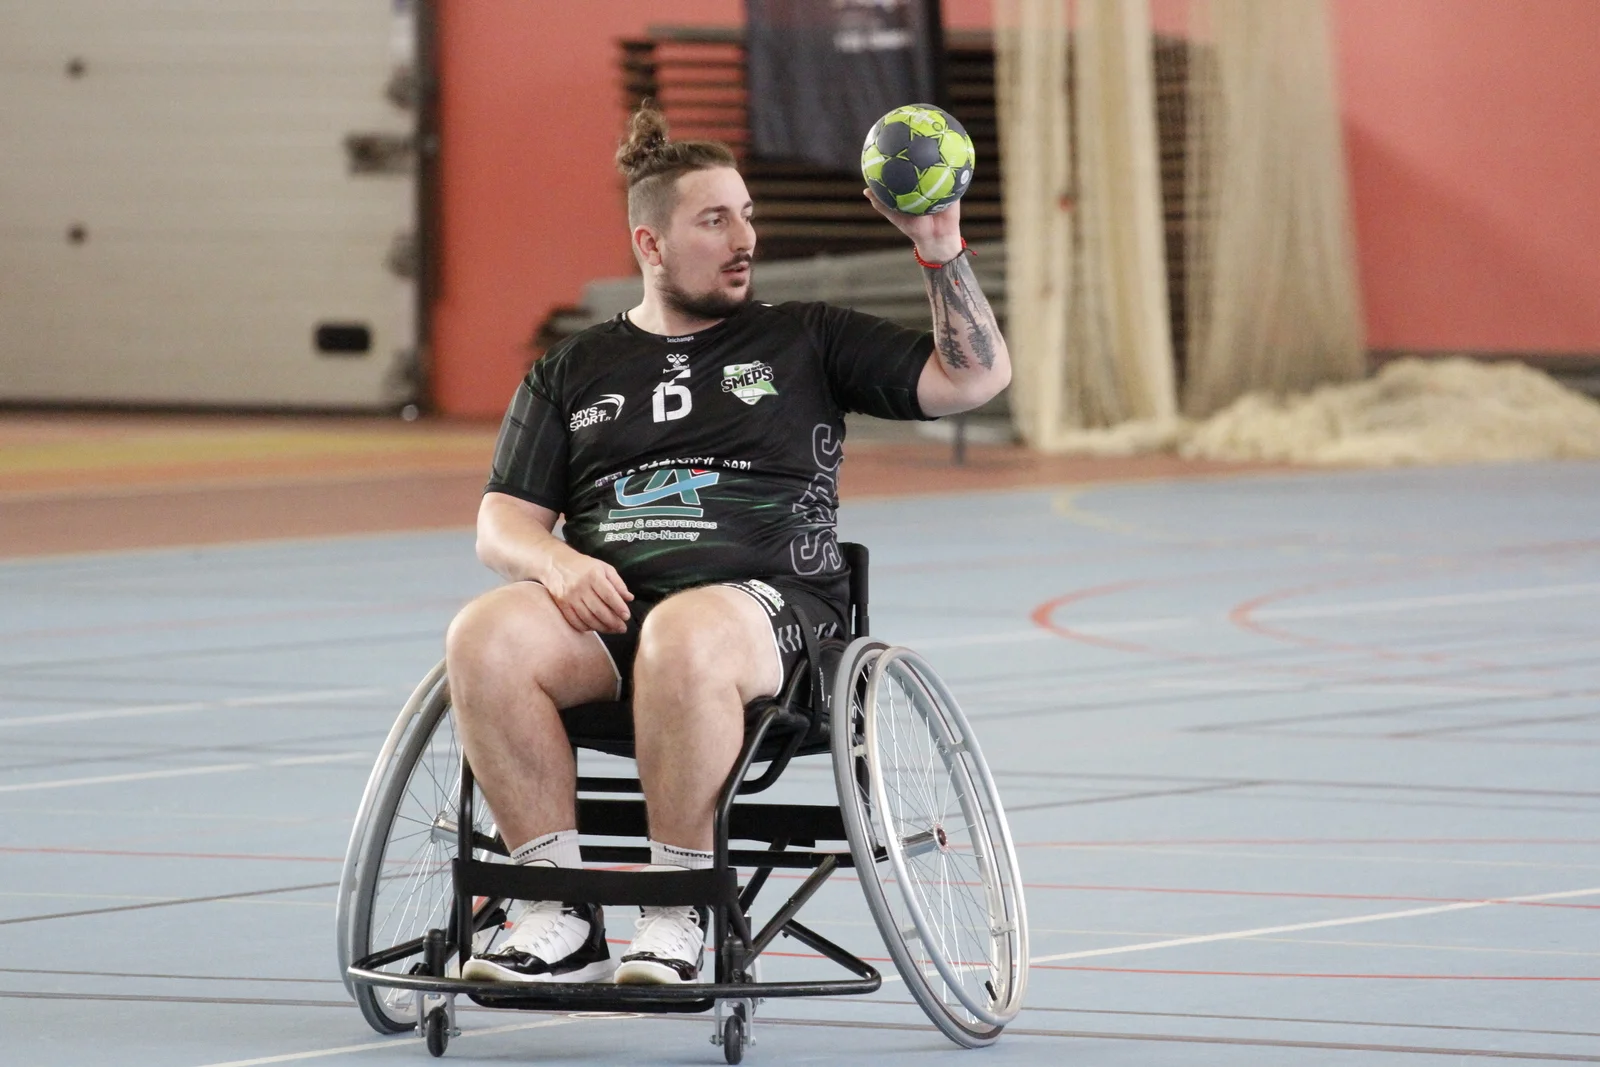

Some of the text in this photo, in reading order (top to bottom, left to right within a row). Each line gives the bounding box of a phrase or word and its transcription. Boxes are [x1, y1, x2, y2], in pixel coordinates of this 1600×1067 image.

[721, 366, 774, 393] SMEPS
[644, 519, 718, 530] assurances
[663, 845, 714, 860] humme
